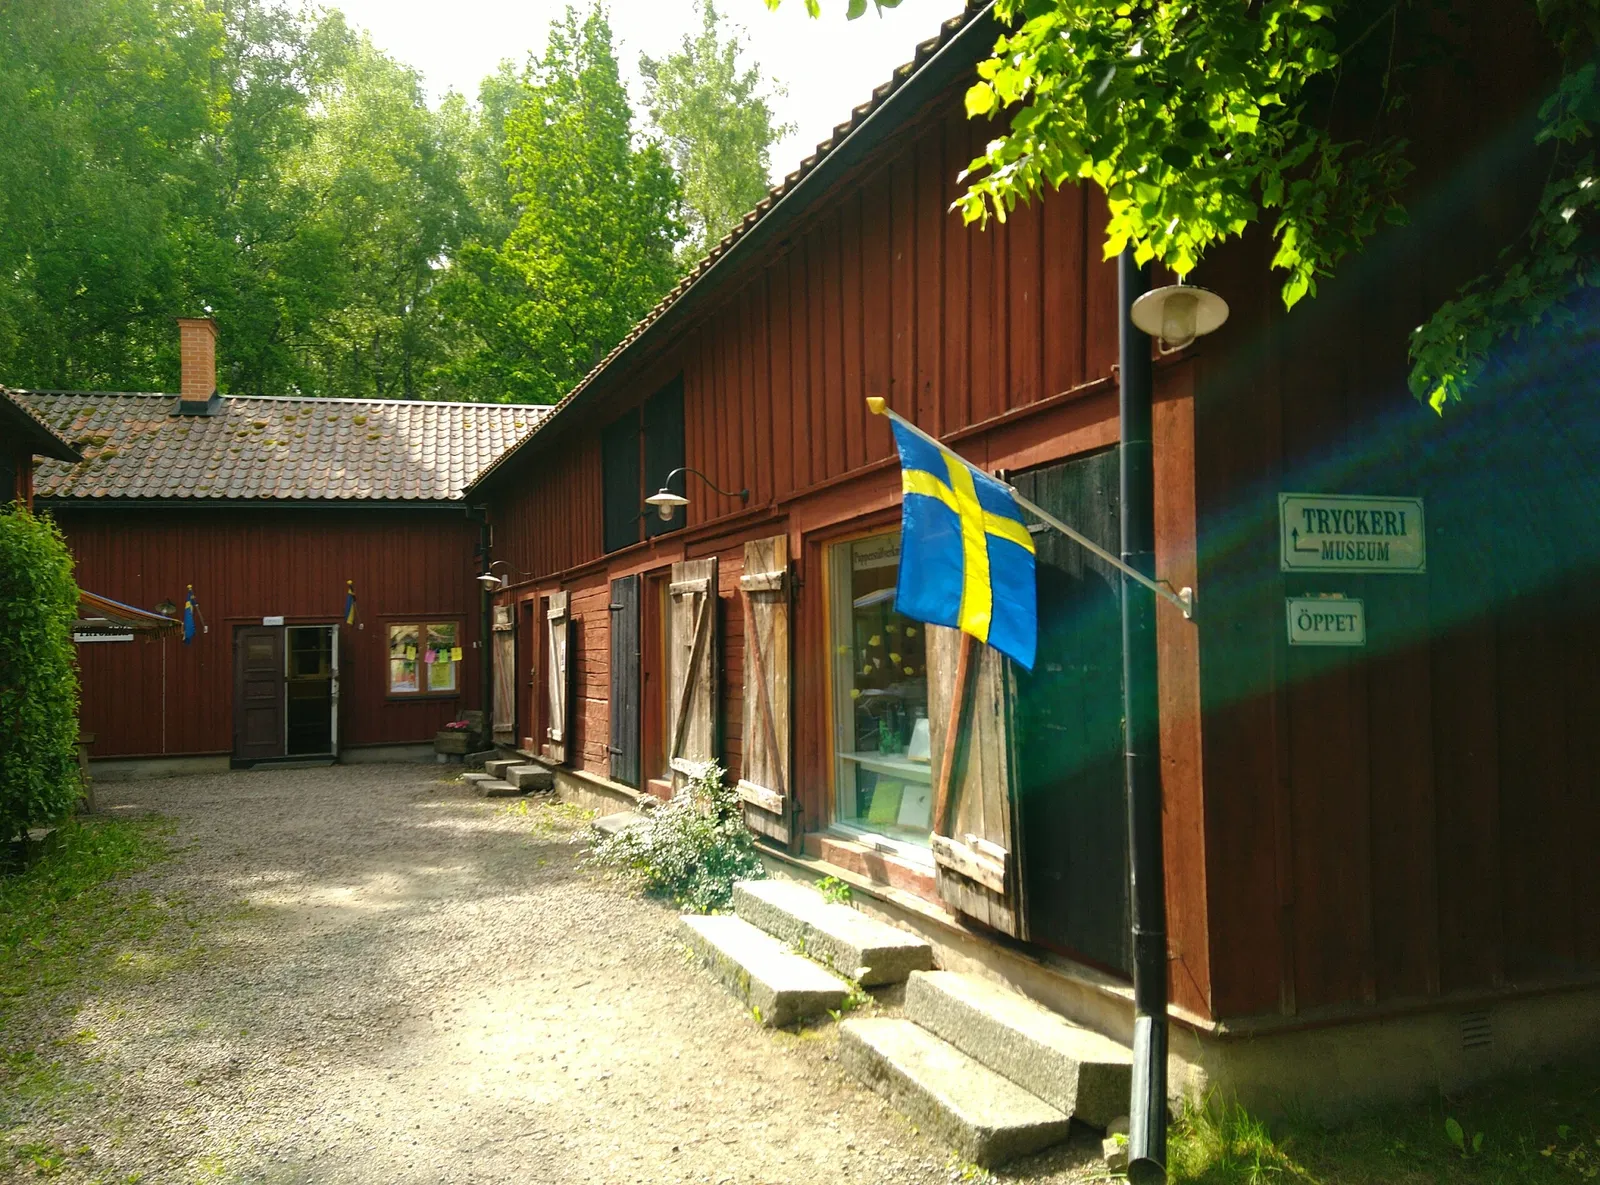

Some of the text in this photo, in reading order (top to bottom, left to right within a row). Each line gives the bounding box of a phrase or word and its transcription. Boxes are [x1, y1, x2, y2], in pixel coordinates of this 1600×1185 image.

[1303, 508, 1407, 536] TRYCKERI
[1321, 540, 1390, 561] MUSEUM
[1297, 608, 1358, 632] ÖPPET
